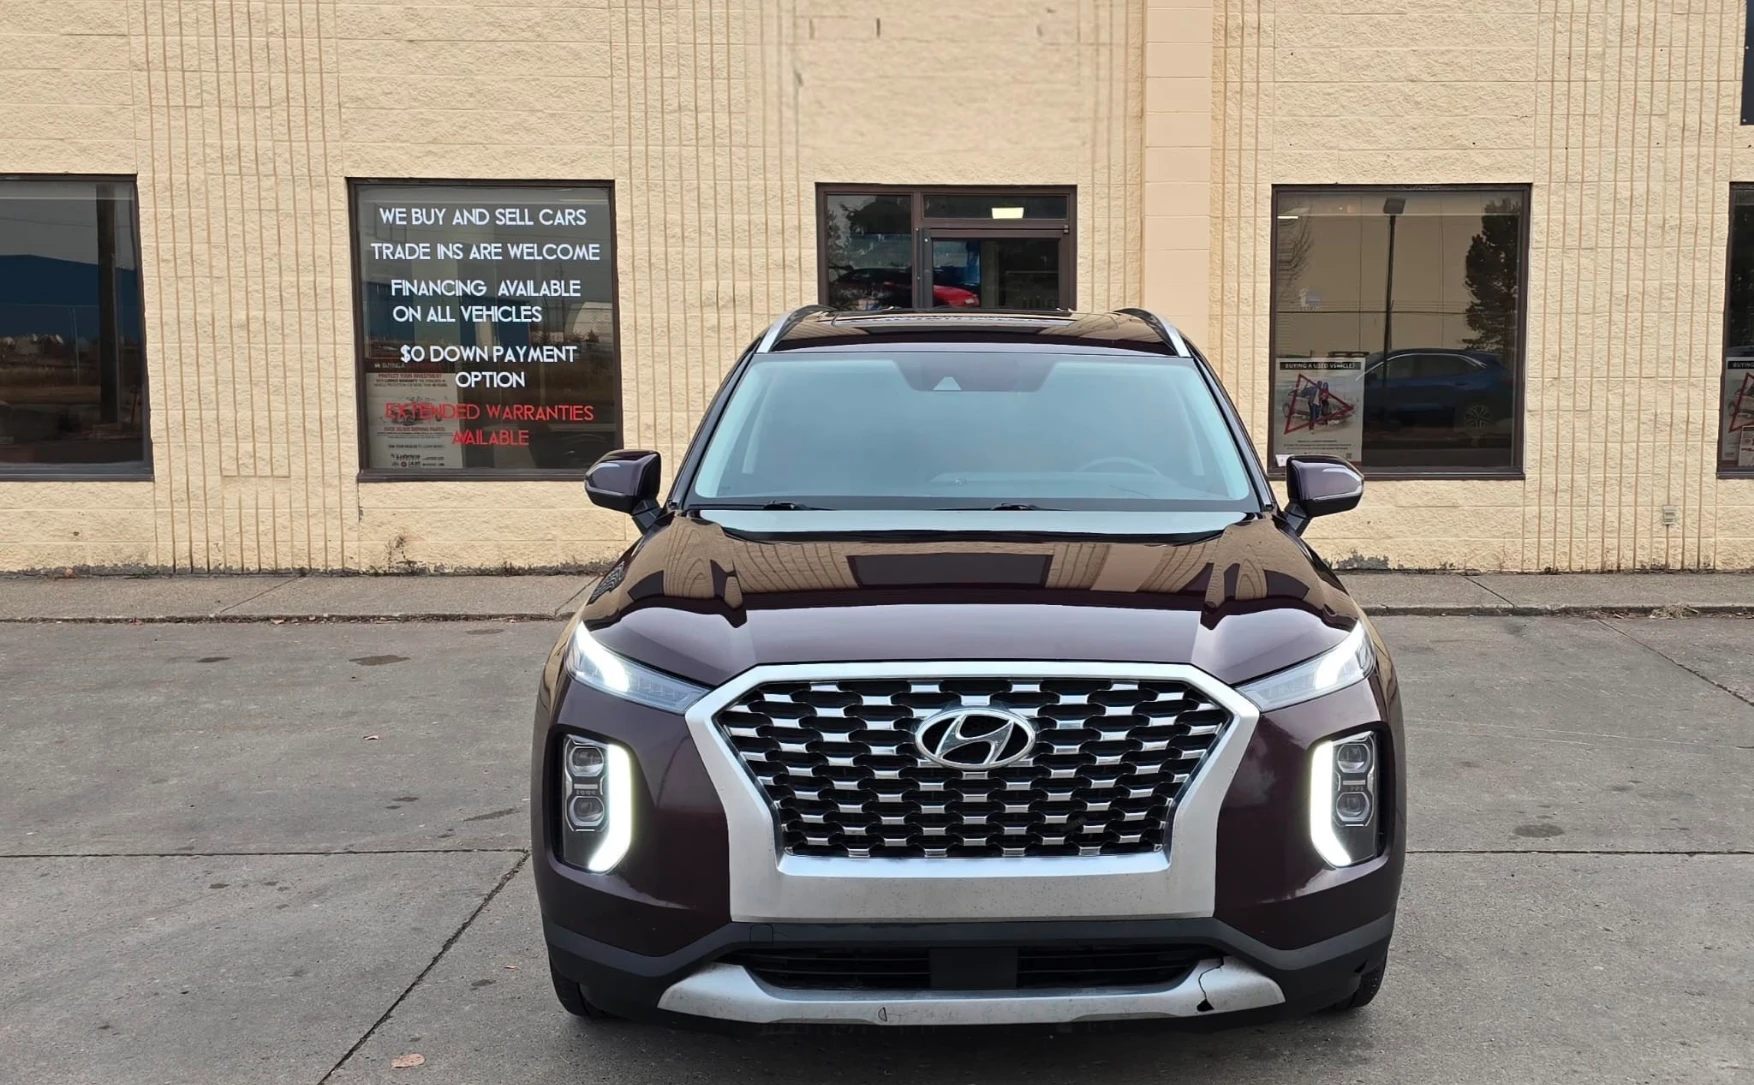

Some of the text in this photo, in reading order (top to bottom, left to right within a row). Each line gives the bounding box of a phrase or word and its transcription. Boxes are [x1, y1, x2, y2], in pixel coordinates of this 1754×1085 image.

[379, 207, 587, 227] WE BUY AND SELL CARS
[370, 242, 600, 261] TRADE INS ARE WELCOME
[390, 279, 581, 298] FINANCING AVAILABLE
[392, 305, 542, 323] ON ALL VEHICLES
[429, 345, 489, 363] DOWN
[492, 345, 577, 363] PAYMENT
[455, 371, 526, 388] OPTION
[384, 402, 594, 422] EXTENDED WARRANTIES
[452, 429, 529, 447] AVAILABLE
